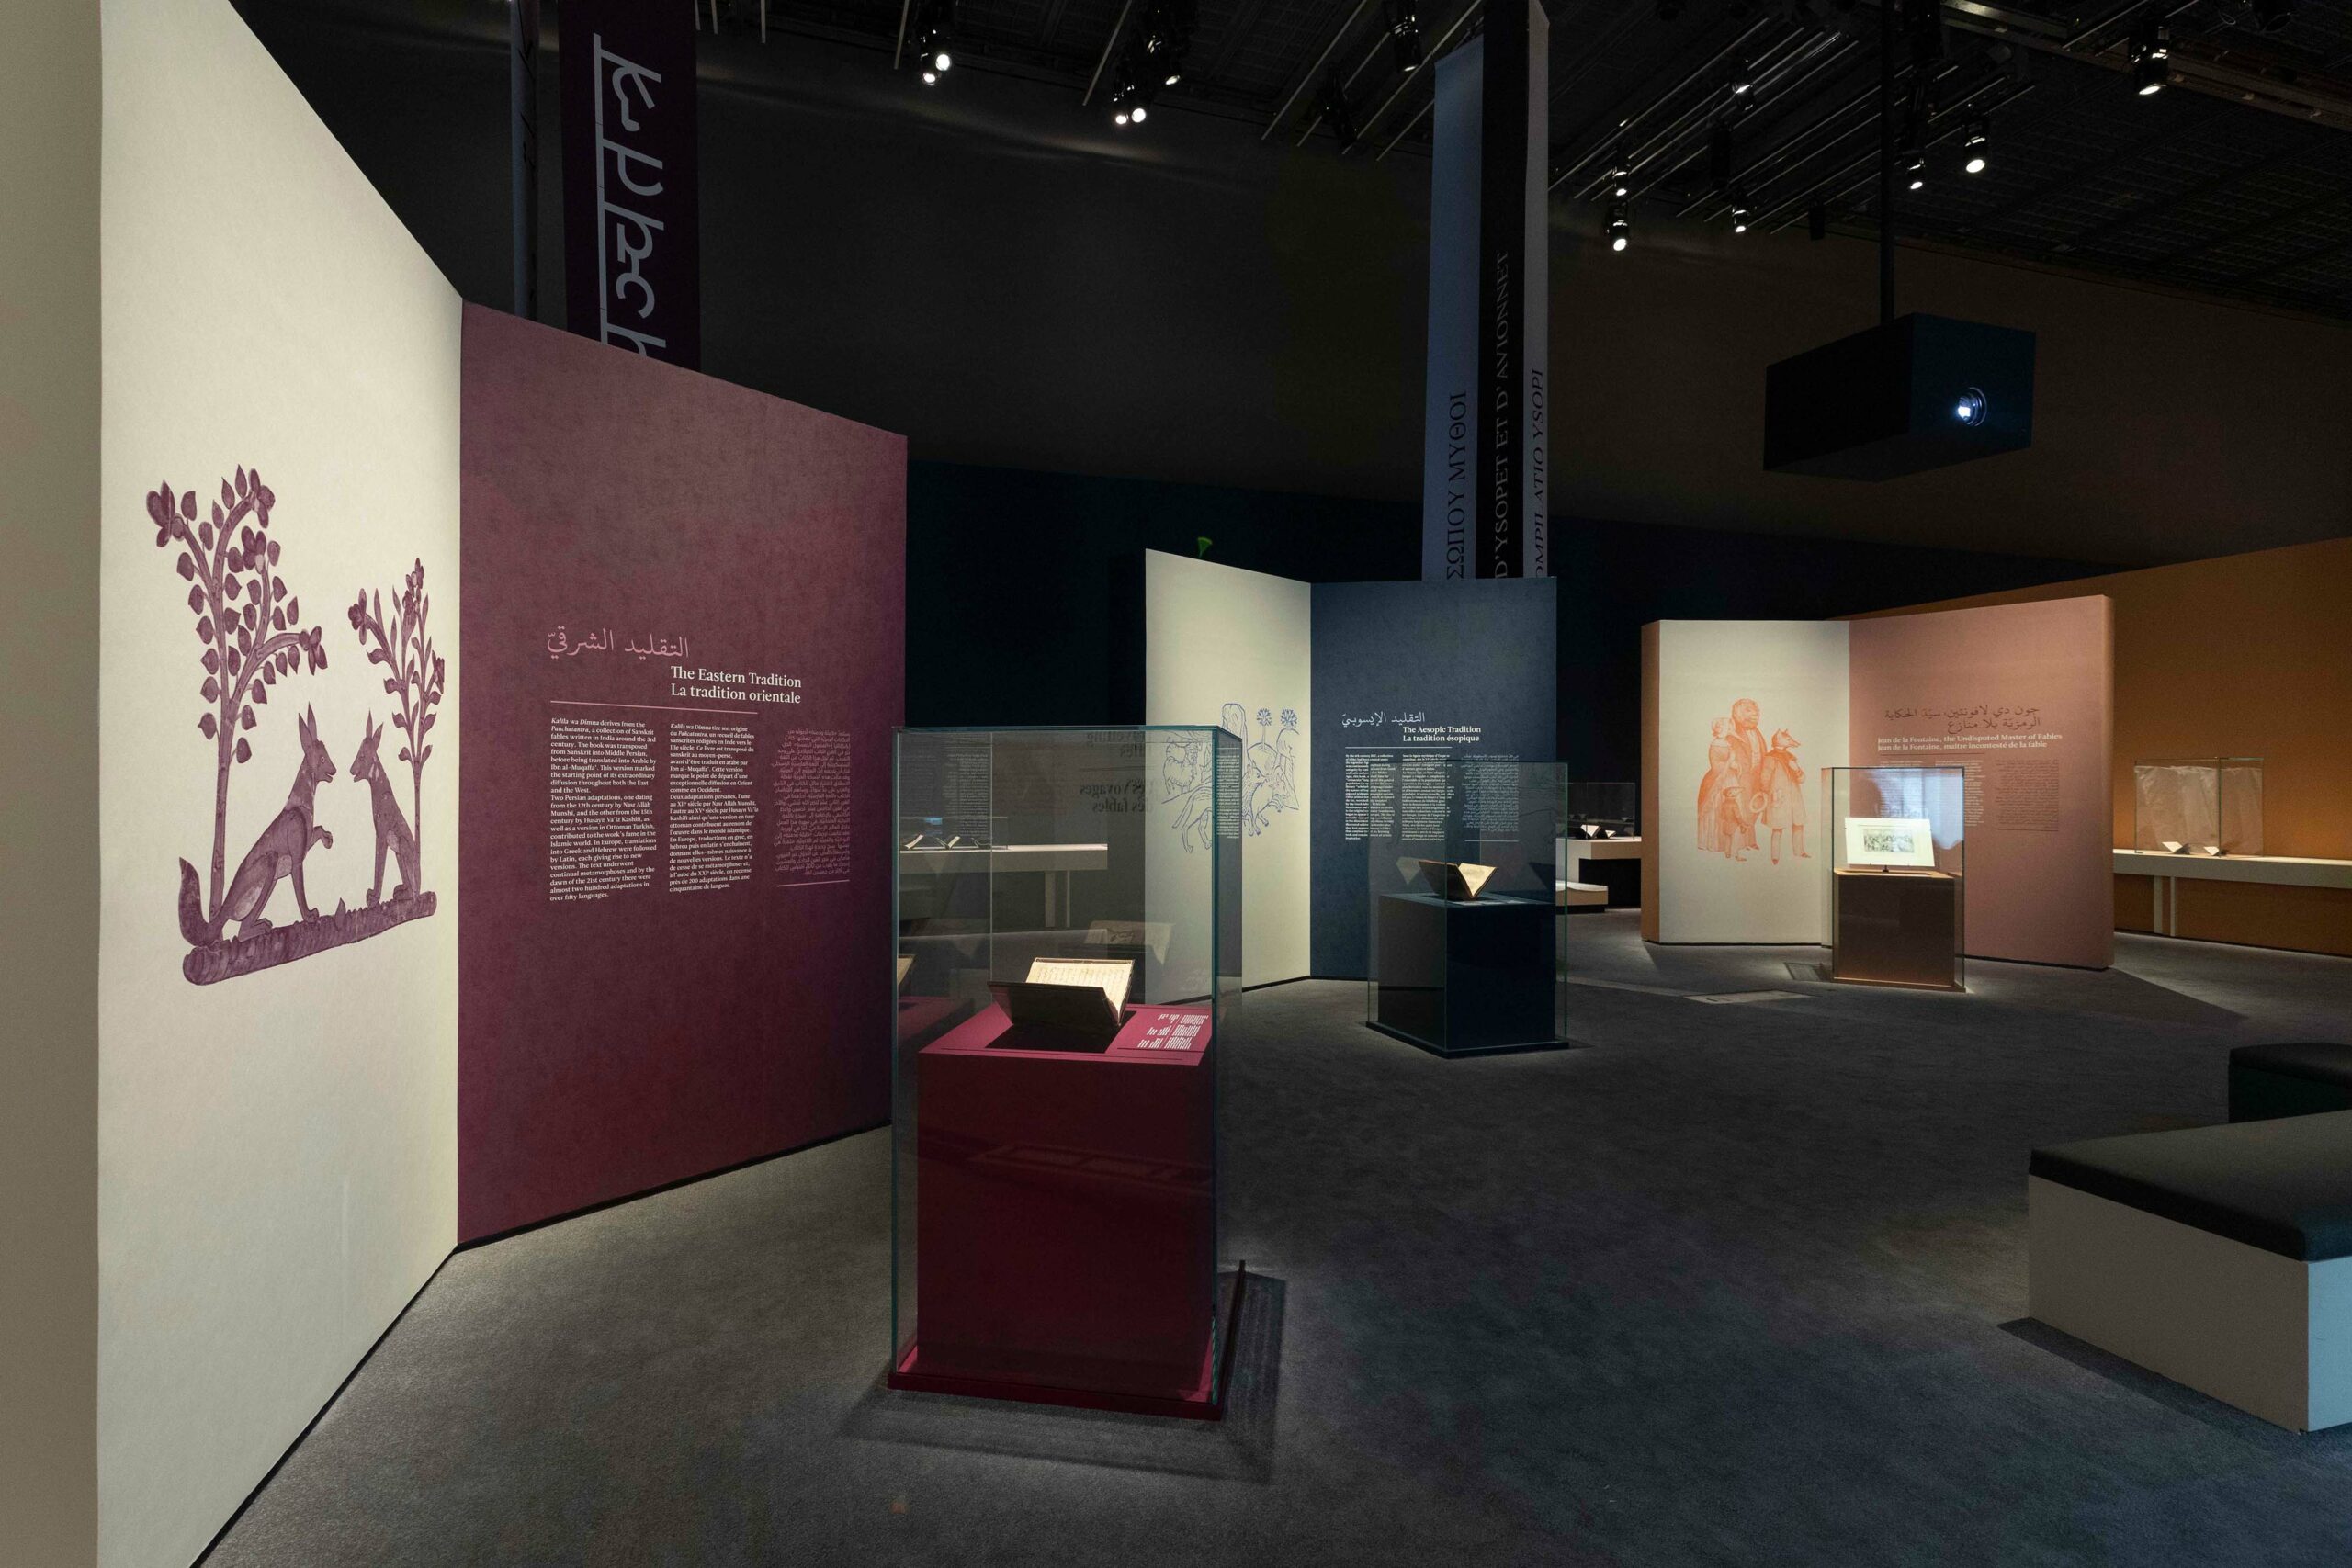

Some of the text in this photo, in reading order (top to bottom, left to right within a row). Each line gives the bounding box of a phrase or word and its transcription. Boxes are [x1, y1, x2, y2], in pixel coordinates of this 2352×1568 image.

[1531, 368, 1544, 440] YSOPI
[1448, 390, 1467, 482] ΜΥΘΟΙ
[1496, 417, 1509, 449] ET
[624, 634, 690, 660] التقليد
[671, 665, 802, 688] The Eastern Tradition
[671, 683, 801, 704] La tradition orientale
[1391, 711, 1425, 726] التقليد
[1884, 707, 1917, 721] الحكاية
[1983, 717, 1998, 728] بلا
[1418, 726, 1446, 735] Aesopic
[1947, 719, 1978, 735] منازع
[1446, 735, 1480, 743] ésopique
